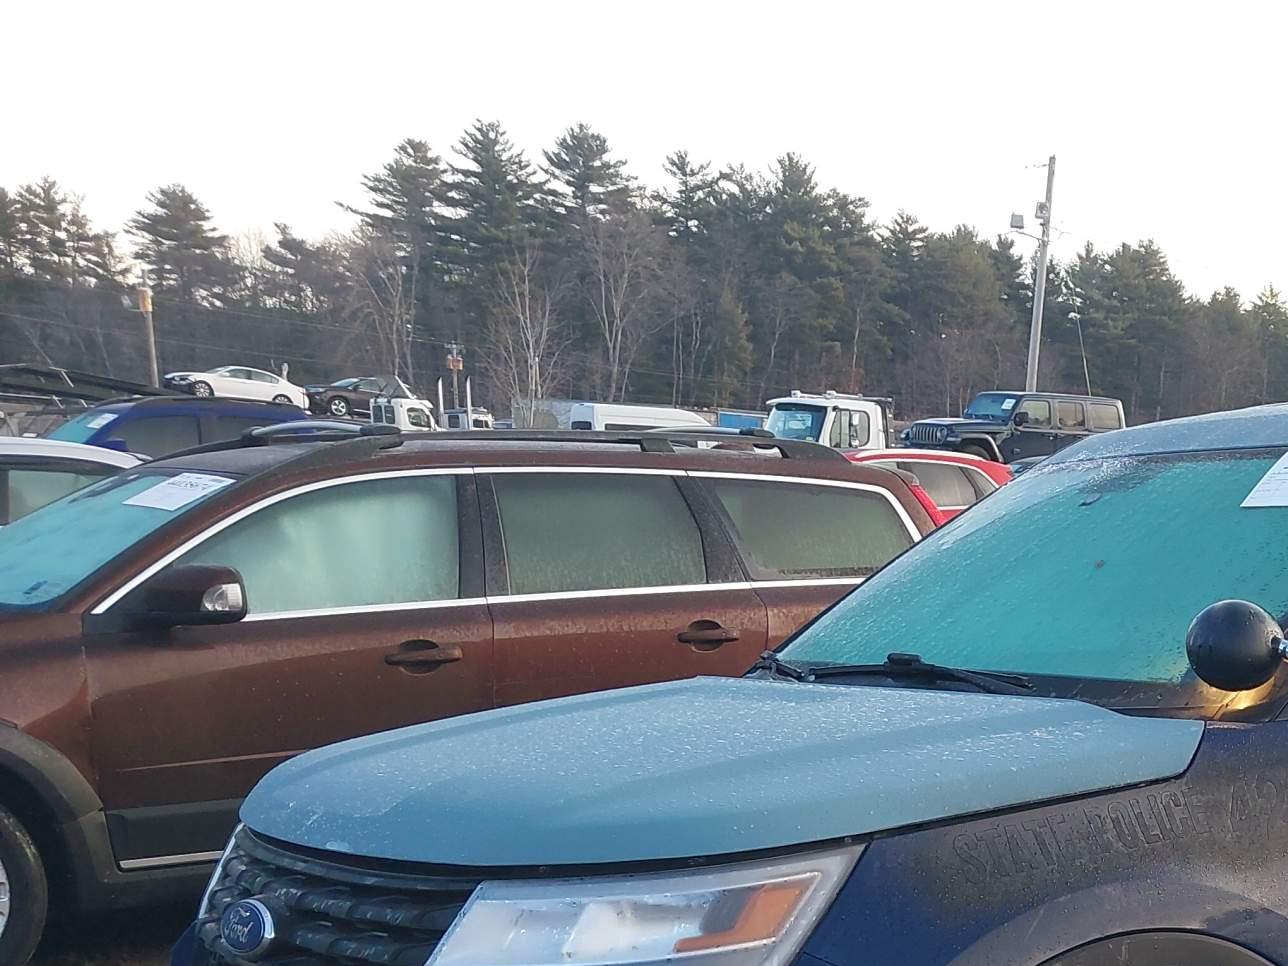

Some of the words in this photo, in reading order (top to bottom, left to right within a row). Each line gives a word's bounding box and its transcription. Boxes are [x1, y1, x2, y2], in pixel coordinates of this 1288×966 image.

[952, 813, 1075, 885] STATE
[1083, 783, 1213, 857] POLICE
[224, 907, 255, 943] Ford
